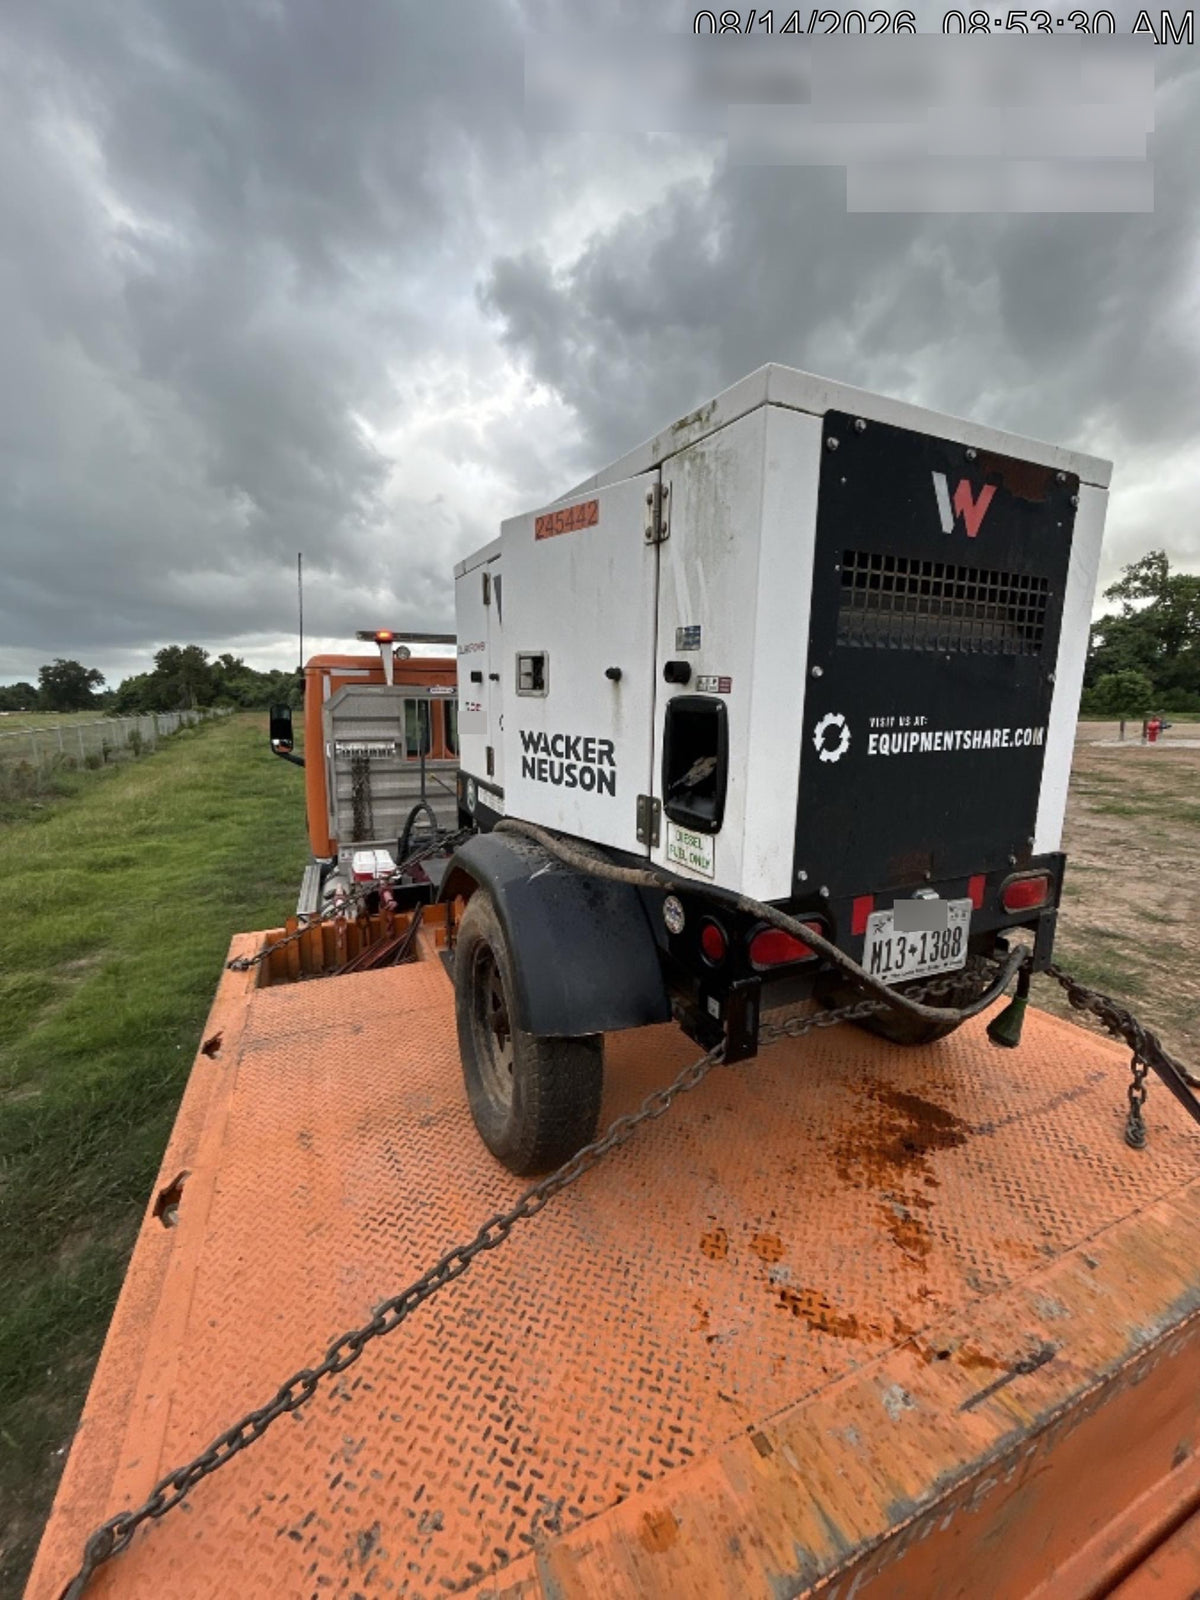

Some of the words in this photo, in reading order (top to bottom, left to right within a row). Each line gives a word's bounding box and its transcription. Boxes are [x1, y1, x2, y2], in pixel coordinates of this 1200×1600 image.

[535, 500, 598, 540] 245442
[869, 716, 895, 728] VISIT
[899, 715, 911, 727] US
[913, 715, 928, 727] AT:
[519, 729, 616, 767] WACKER
[867, 727, 1044, 756] EQUIPMENTSHARE.COM
[522, 755, 616, 797] NEUSON
